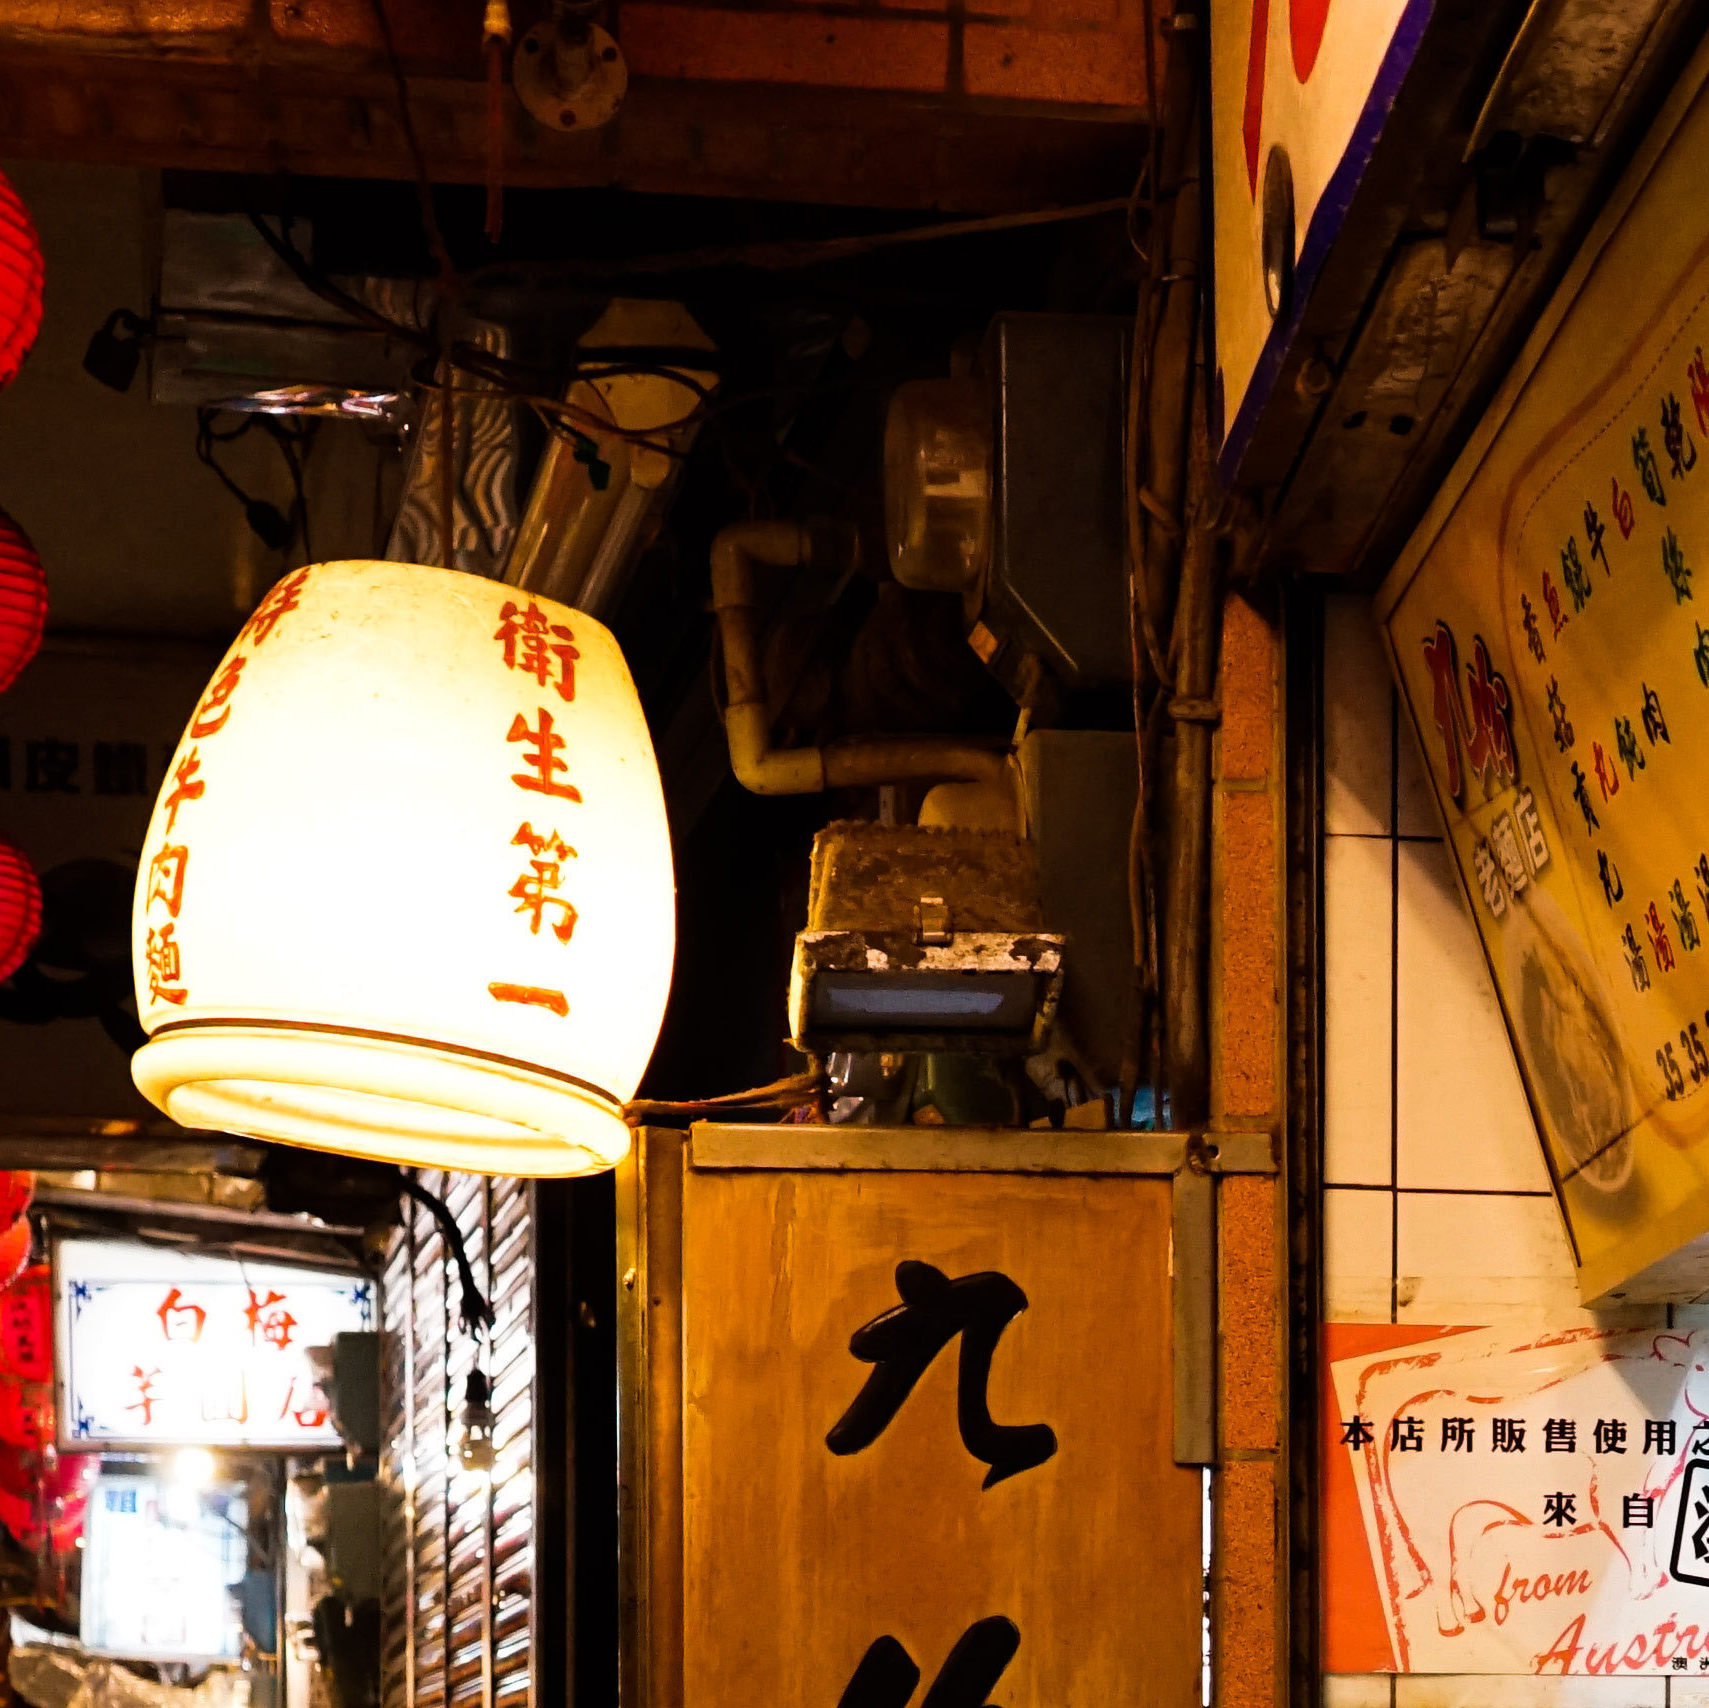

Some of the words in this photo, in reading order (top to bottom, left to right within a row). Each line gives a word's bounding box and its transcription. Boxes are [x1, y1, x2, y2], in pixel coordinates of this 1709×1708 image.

[145, 566, 311, 1006] 特色牛肉麵
[487, 600, 583, 1018] 衛生第一
[1422, 619, 1518, 800] 九份
[1473, 785, 1551, 921] 老麵店
[1522, 596, 1649, 989] 香菇貢丸湯
[1656, 1042, 1684, 1100] 35
[1543, 572, 1674, 970] 魚丸湯
[1680, 1022, 1709, 1082] 35
[1561, 538, 1699, 949] 餛飩湯
[155, 1282, 299, 1351] 白梅
[1493, 1564, 1593, 1626] from
[1541, 1491, 1656, 1530] 來自
